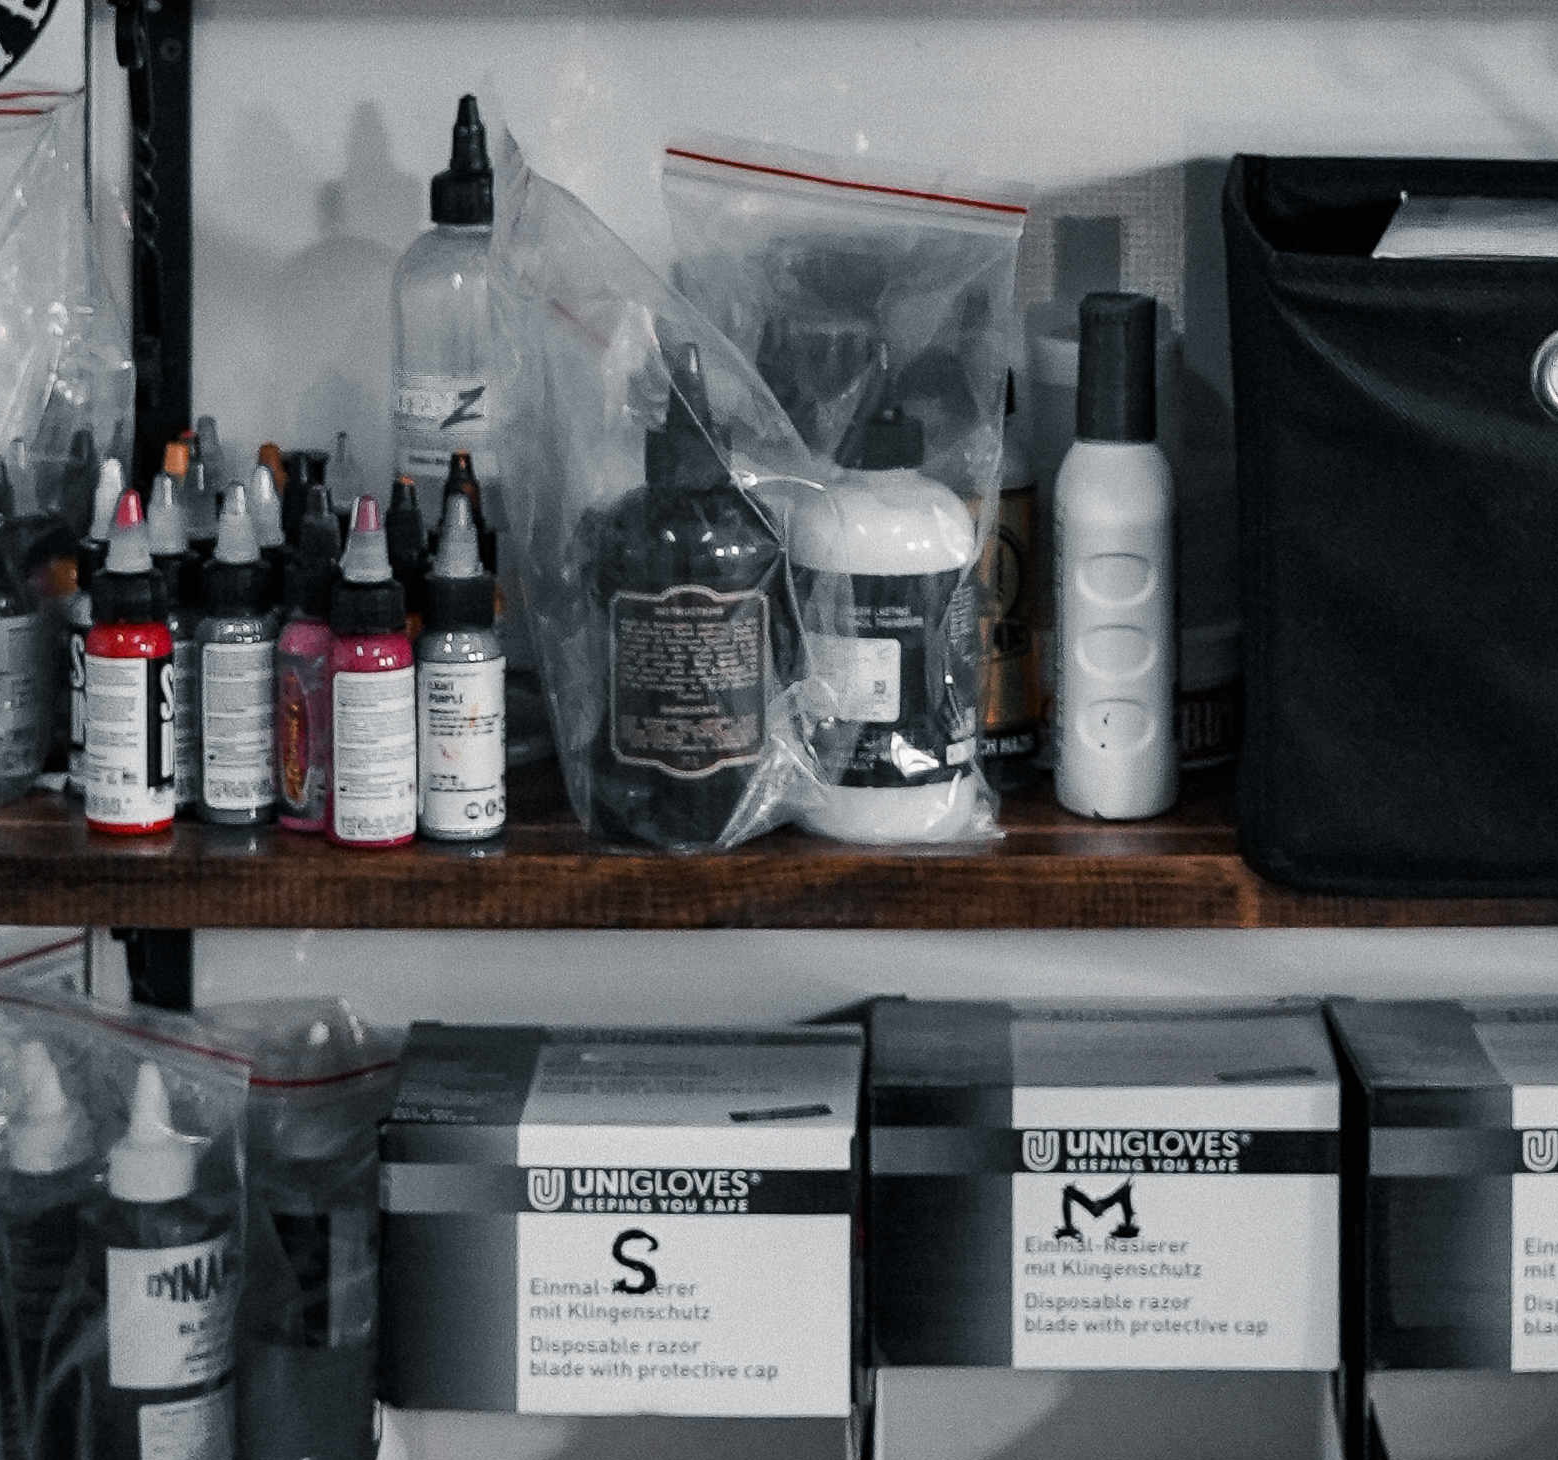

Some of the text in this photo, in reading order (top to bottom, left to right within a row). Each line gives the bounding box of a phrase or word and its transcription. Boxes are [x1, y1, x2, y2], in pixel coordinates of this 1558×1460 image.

[1066, 1131, 1239, 1157] UNIGLOVES
[1066, 1159, 1239, 1171] KEEPING YOU SAFE
[572, 1171, 749, 1196] UNIGLOVES
[571, 1198, 748, 1212] KEEPING YOU SAFE
[1054, 1181, 1140, 1239] M
[612, 1229, 658, 1294] S
[1025, 1293, 1132, 1312] Disposable
[1085, 1318, 1124, 1333] with
[1130, 1319, 1227, 1336] protective
[1235, 1321, 1268, 1336] cap
[531, 1336, 640, 1355] Disposable
[591, 1362, 632, 1376] with
[639, 1362, 736, 1380] protective
[745, 1366, 778, 1380] cap
